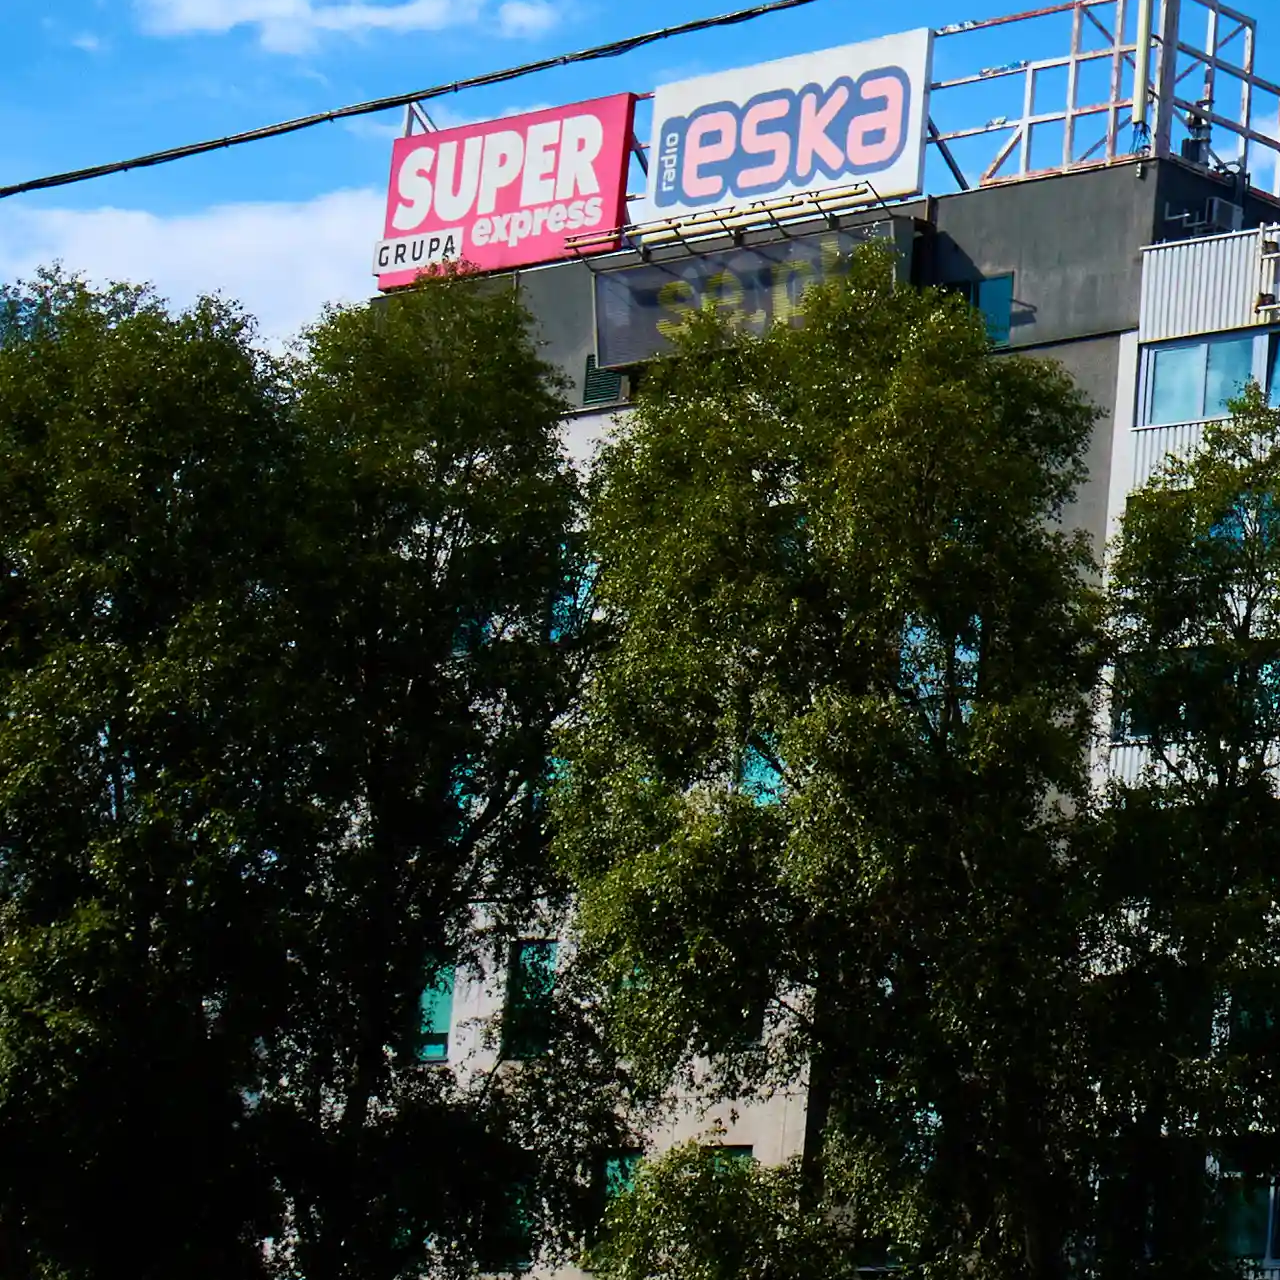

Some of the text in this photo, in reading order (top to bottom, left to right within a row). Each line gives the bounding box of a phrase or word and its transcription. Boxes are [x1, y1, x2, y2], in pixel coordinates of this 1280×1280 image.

[661, 132, 679, 192] radio
[682, 76, 904, 198] eska
[392, 114, 604, 231] SUPER
[378, 235, 456, 267] GRUPA
[470, 196, 604, 247] express
